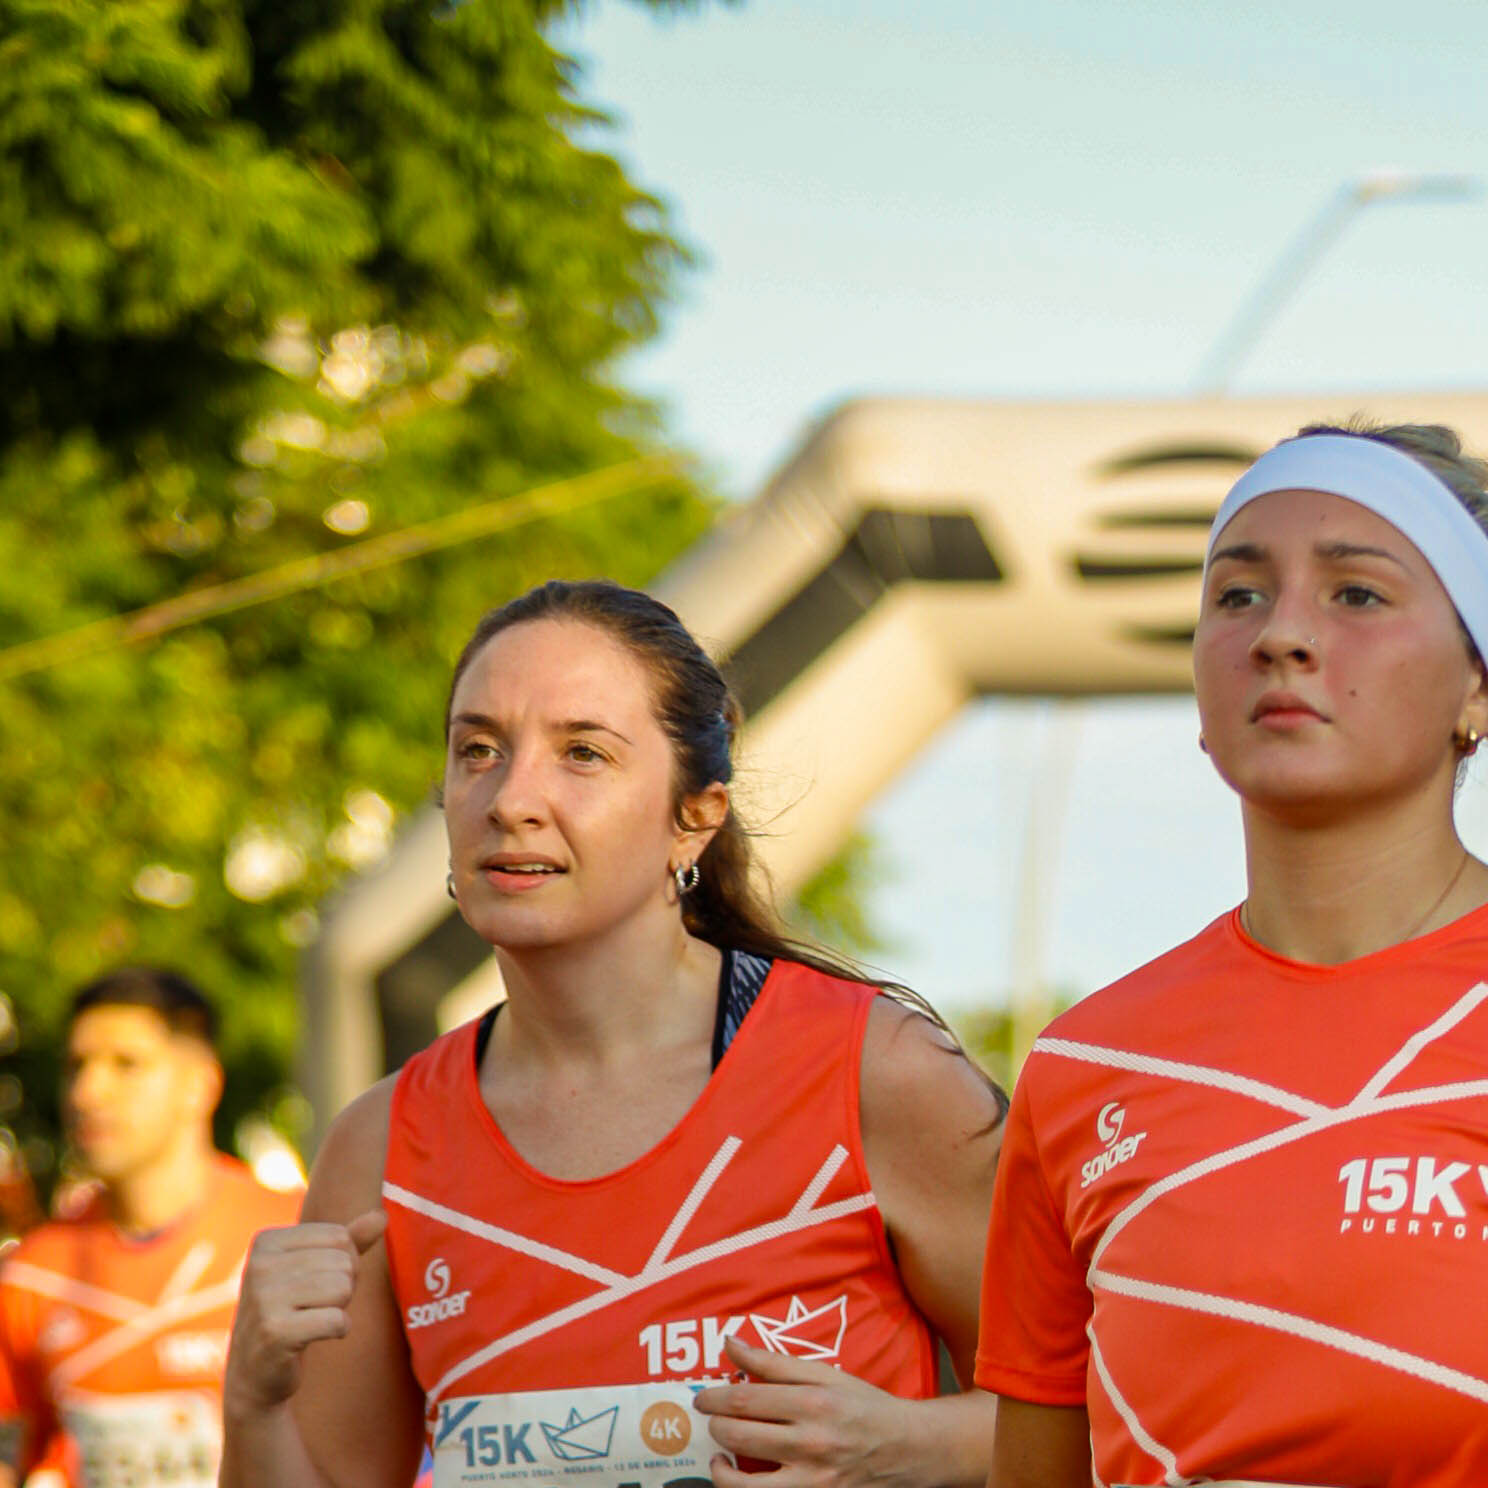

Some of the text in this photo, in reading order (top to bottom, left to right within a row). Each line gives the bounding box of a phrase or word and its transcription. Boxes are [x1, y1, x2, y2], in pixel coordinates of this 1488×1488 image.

[1338, 1156, 1472, 1218] 15K
[1340, 1218, 1466, 1239] PUERTO
[639, 1316, 746, 1375] 15K
[460, 1422, 537, 1467] 15K
[650, 1416, 683, 1440] 4K
